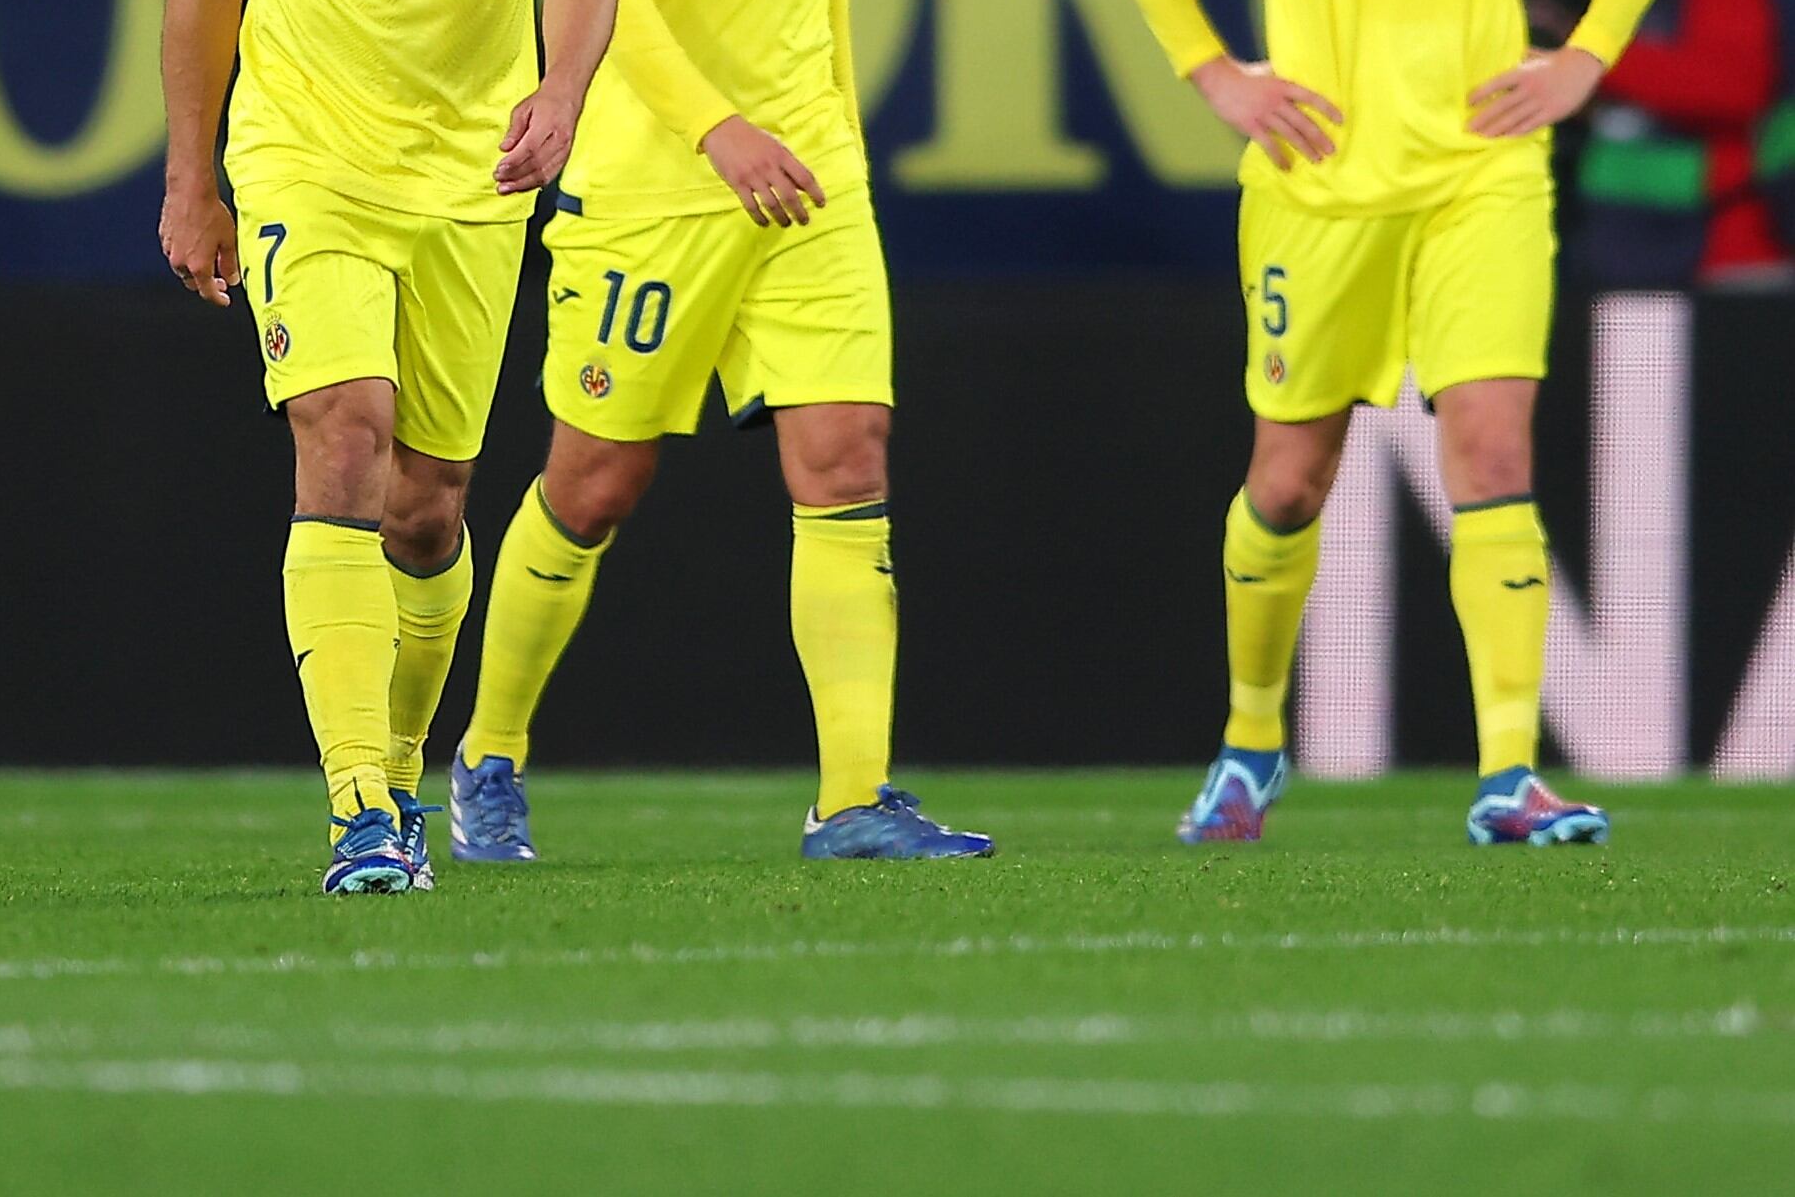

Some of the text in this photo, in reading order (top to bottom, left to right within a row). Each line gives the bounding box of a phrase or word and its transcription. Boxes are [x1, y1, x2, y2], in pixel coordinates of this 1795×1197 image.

[258, 222, 288, 305] 7
[1263, 266, 1289, 338] 5
[597, 269, 673, 355] 10
